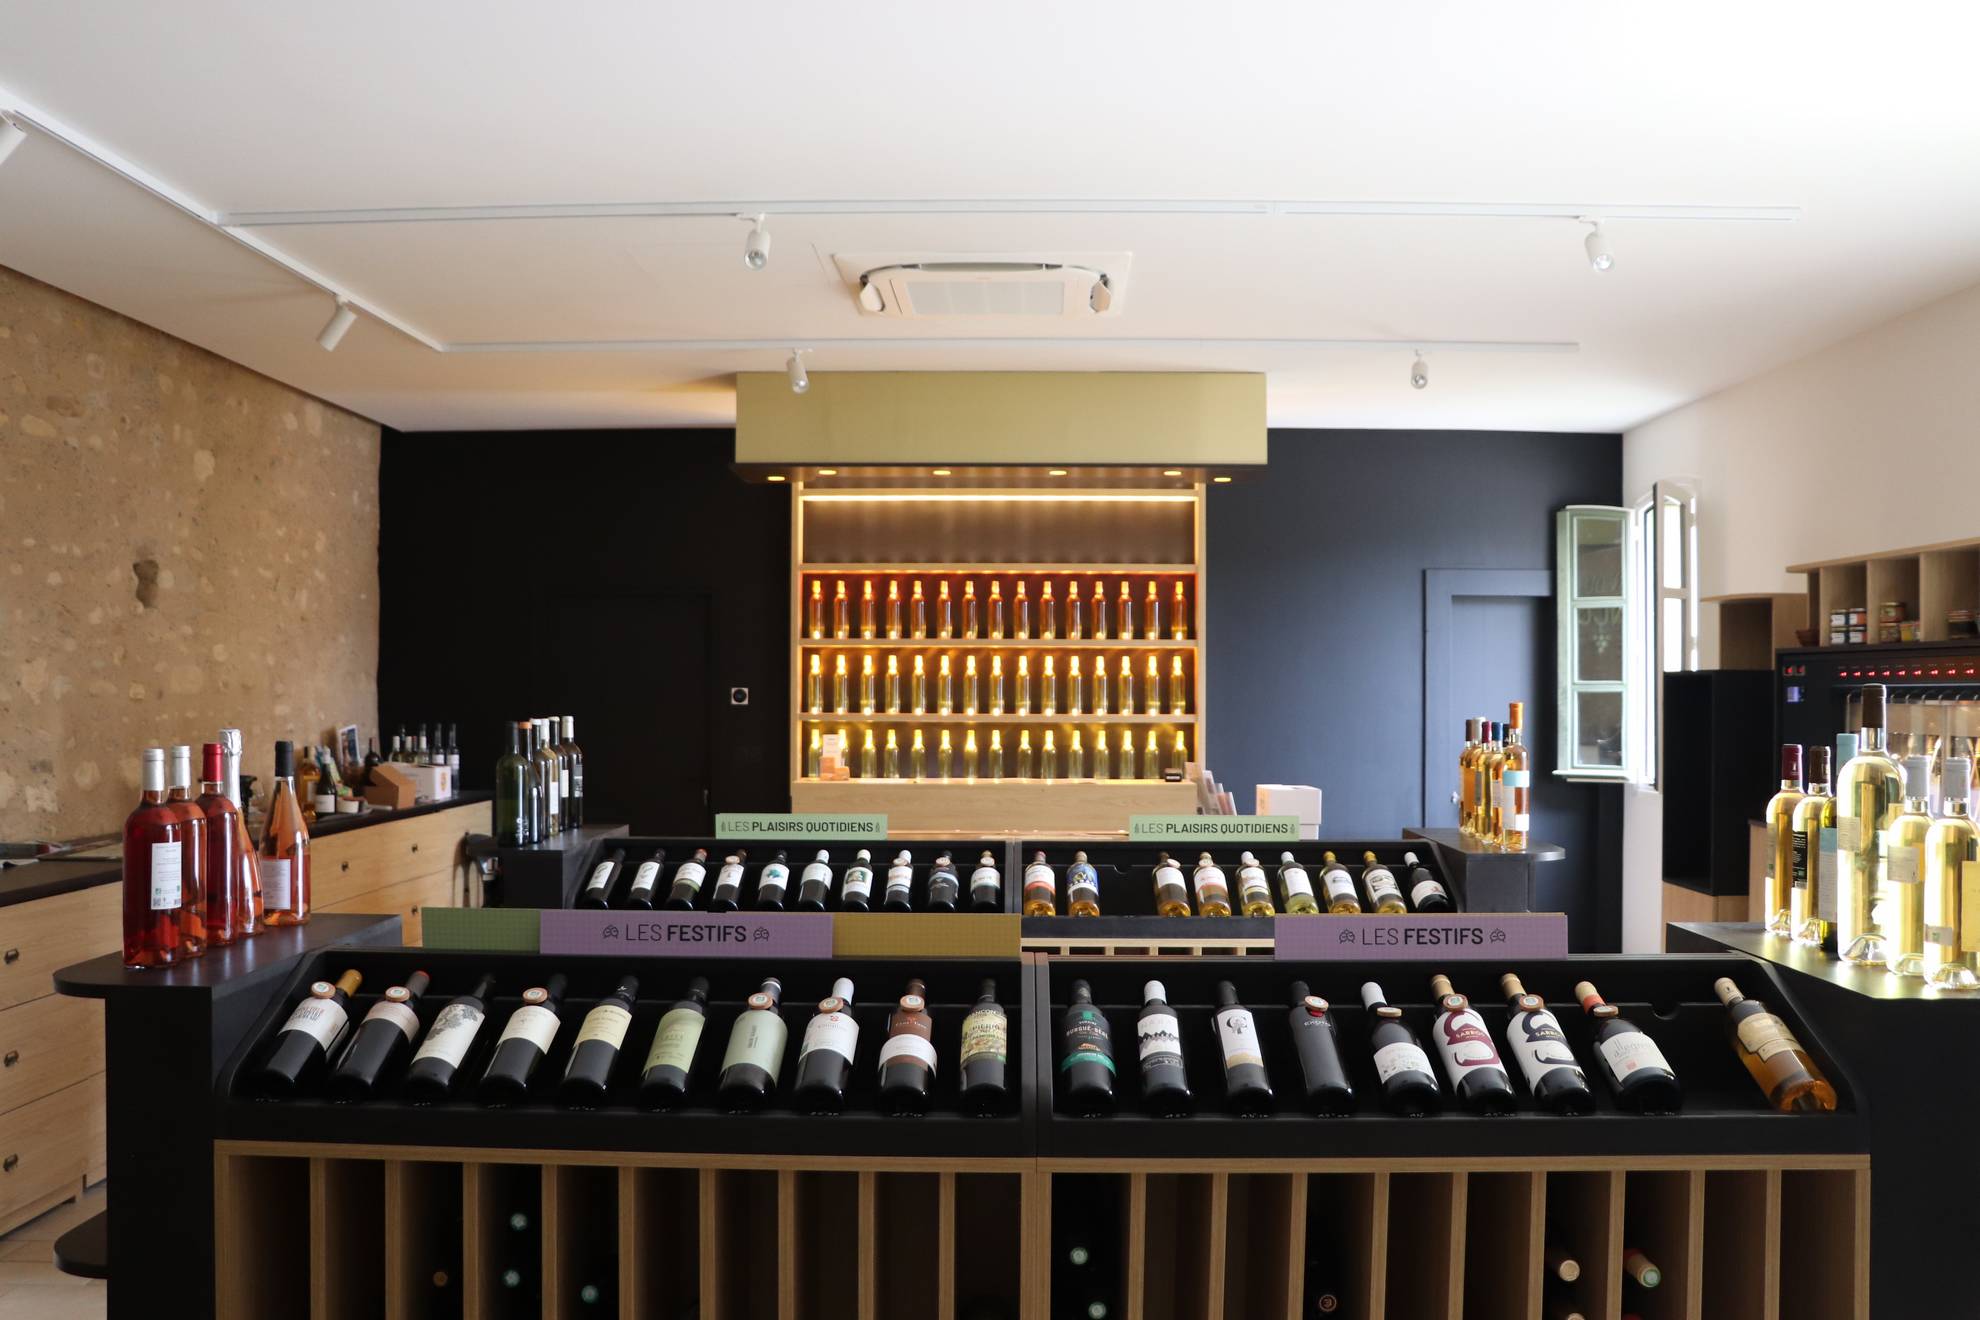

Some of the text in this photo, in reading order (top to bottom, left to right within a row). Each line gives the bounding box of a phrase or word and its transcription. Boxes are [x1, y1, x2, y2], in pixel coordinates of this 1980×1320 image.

[728, 821, 874, 833] LES PLAISIRS QUOTIDIENS
[1141, 823, 1289, 835] LES PLAISIRS QUOTIDIENS
[625, 923, 747, 942] LES FESTIFS
[1362, 927, 1484, 946] LES FESTIFS
